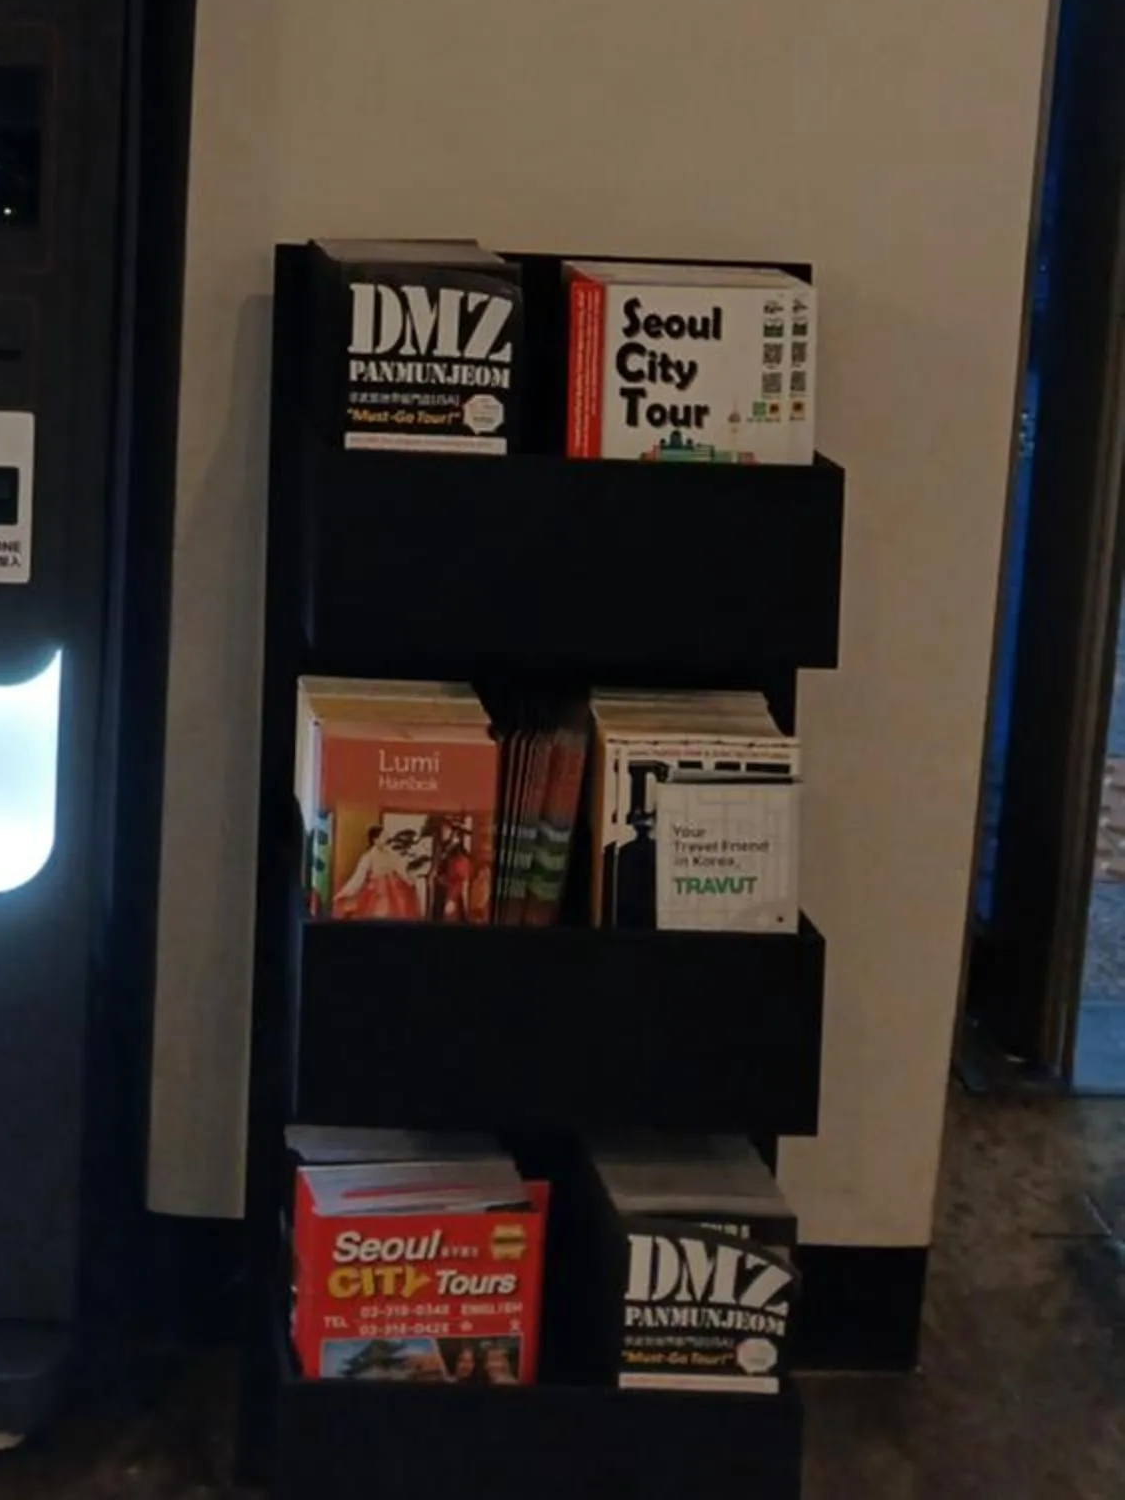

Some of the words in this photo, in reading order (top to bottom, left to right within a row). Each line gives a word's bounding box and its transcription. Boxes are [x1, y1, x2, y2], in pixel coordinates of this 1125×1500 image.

[348, 282, 513, 362] DMZ
[621, 297, 723, 340] Seoul
[349, 361, 511, 389] PANMUNJEOM
[616, 342, 698, 391] City
[619, 387, 710, 430] Tour
[379, 749, 440, 773] Lumi
[379, 774, 439, 792] Hanbok
[672, 825, 705, 838] Your
[674, 840, 718, 852] Travel
[674, 877, 757, 894] TRAVUT
[332, 1229, 443, 1263] Seoul
[328, 1265, 431, 1298] CITY
[435, 1269, 518, 1295] Tours
[624, 1234, 794, 1317] DMZ
[323, 1316, 348, 1328] TEL
[625, 1305, 786, 1336] PANMUNJEOM
